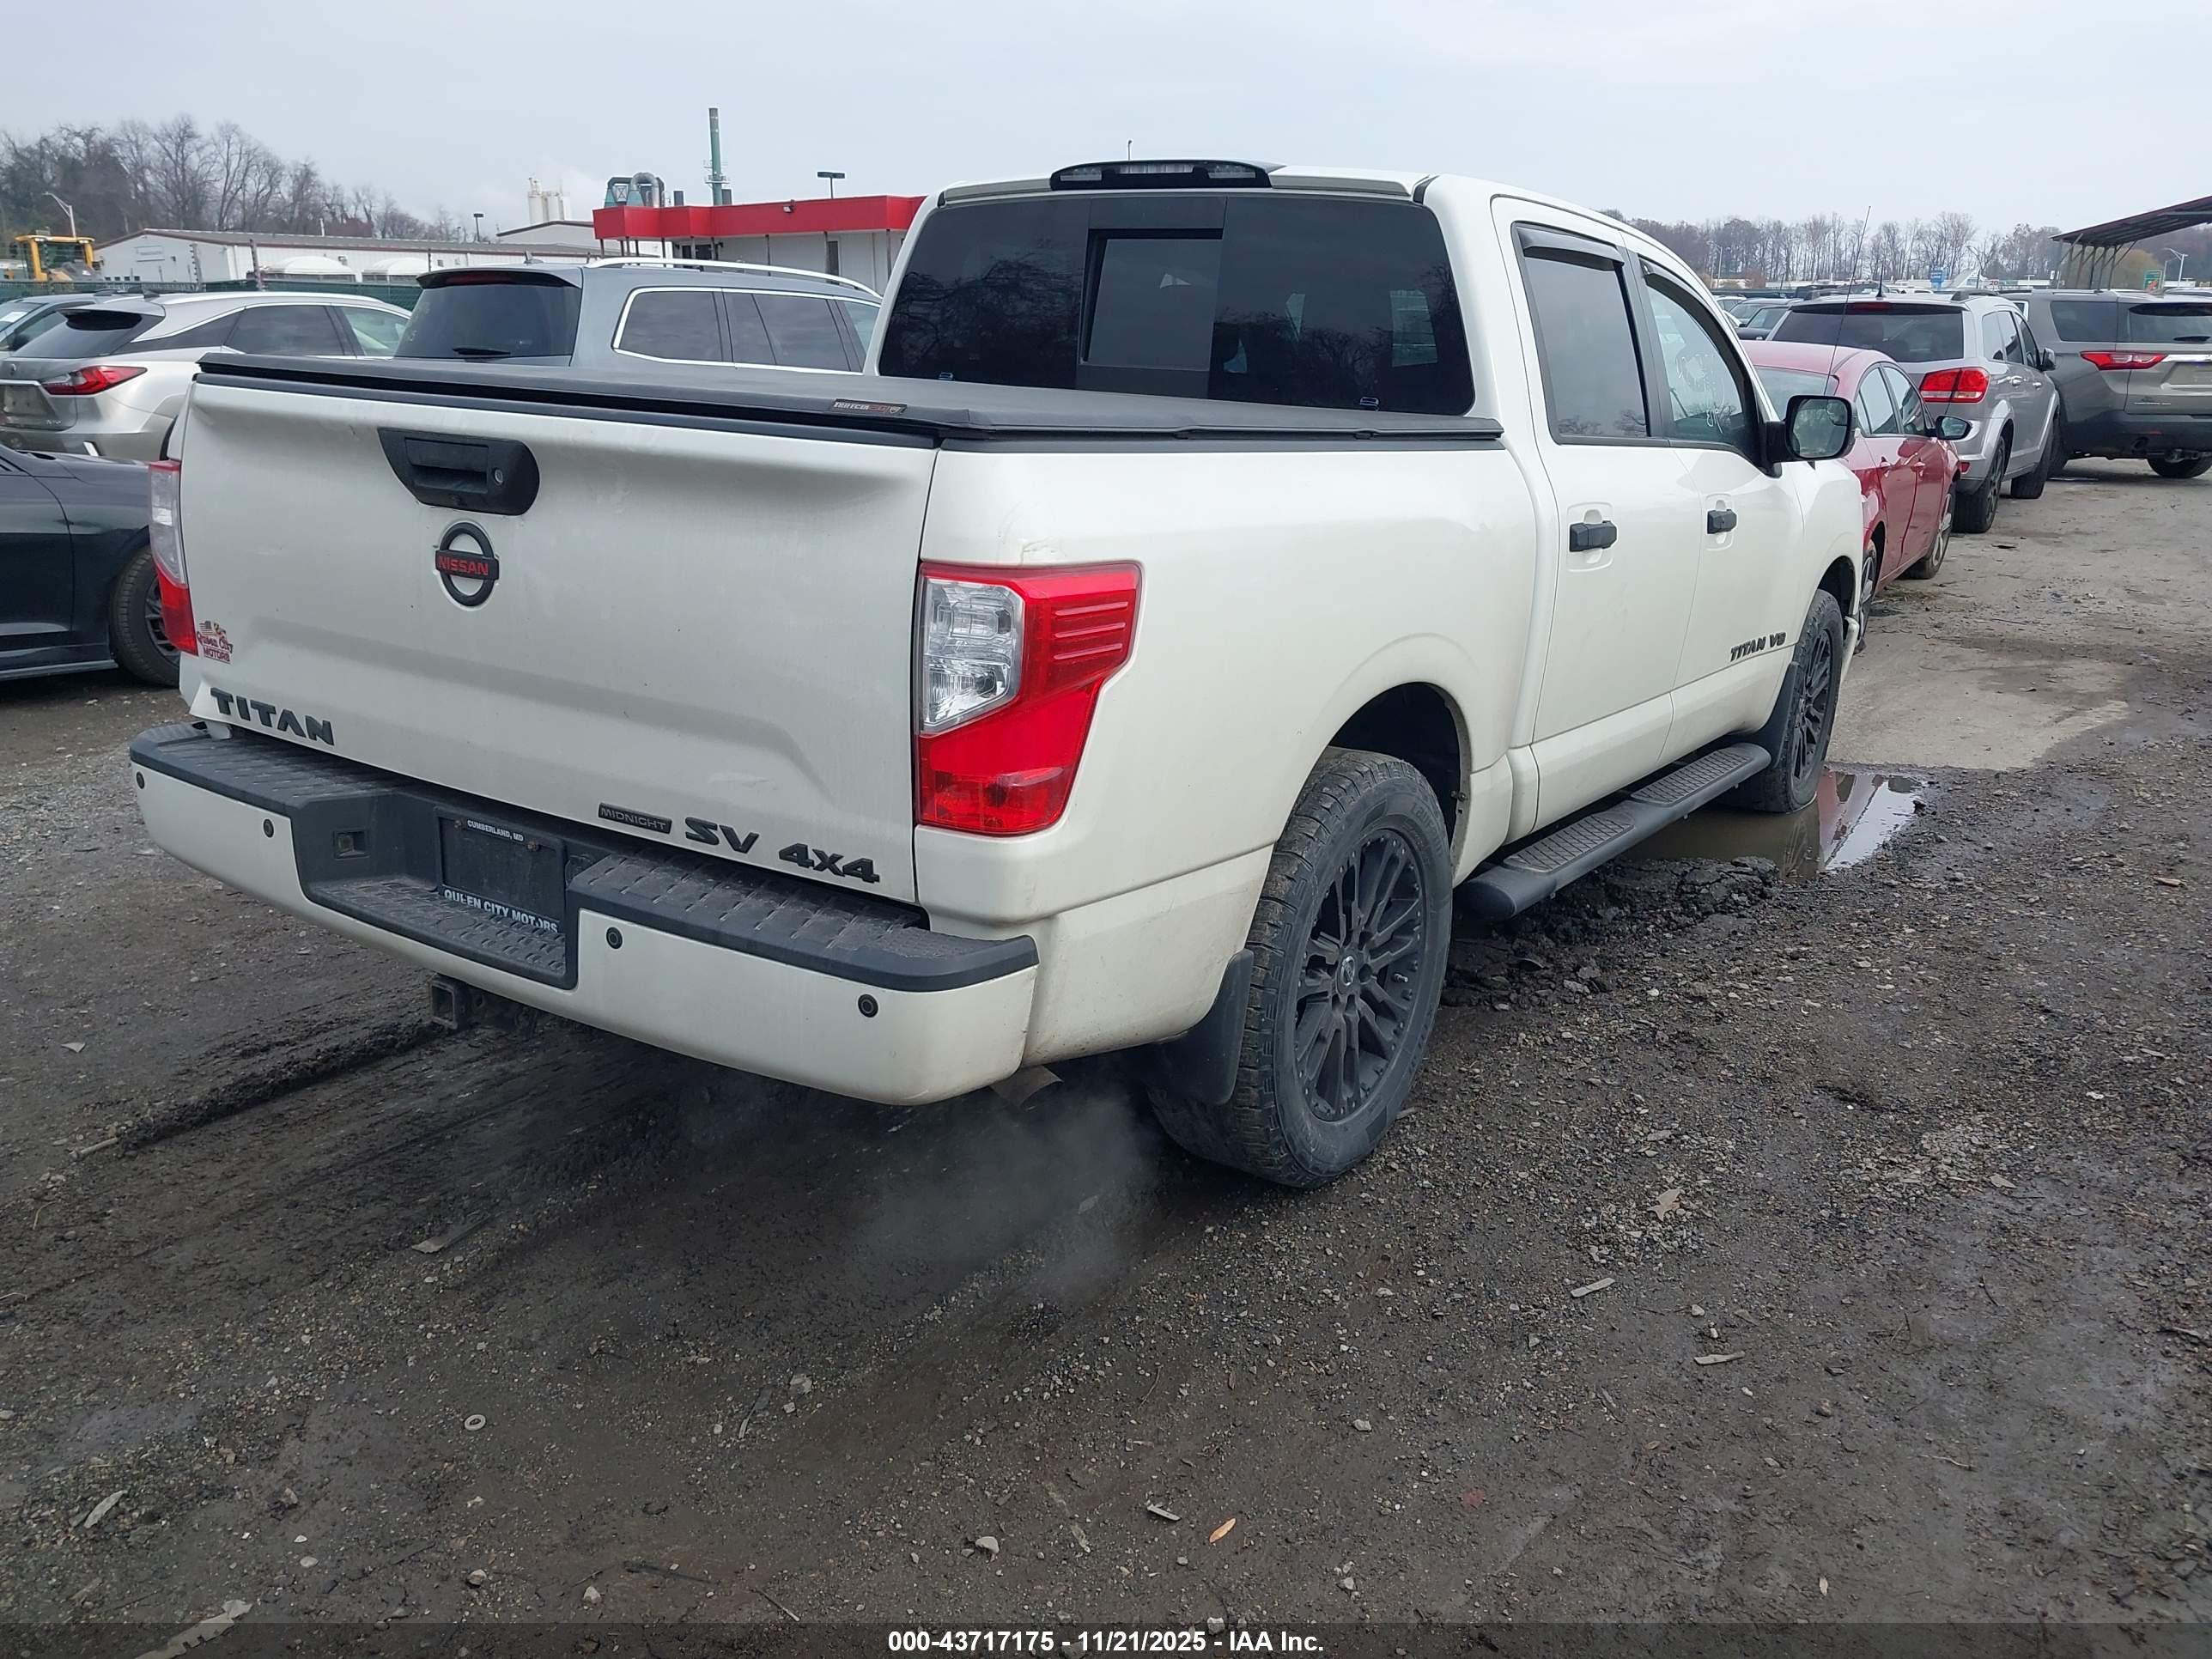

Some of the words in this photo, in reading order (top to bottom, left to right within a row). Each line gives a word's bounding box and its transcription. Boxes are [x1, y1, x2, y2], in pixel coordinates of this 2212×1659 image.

[439, 556, 489, 576] NISSAN
[1729, 635, 1767, 663] TITAN
[210, 687, 335, 746] TITAN
[467, 819, 513, 841] CUMBERLAND,
[513, 832, 524, 842] MD
[601, 807, 666, 830] MIDNIGHT
[685, 817, 759, 854] SV
[444, 889, 482, 910] QUEEN
[483, 902, 509, 917] CITY
